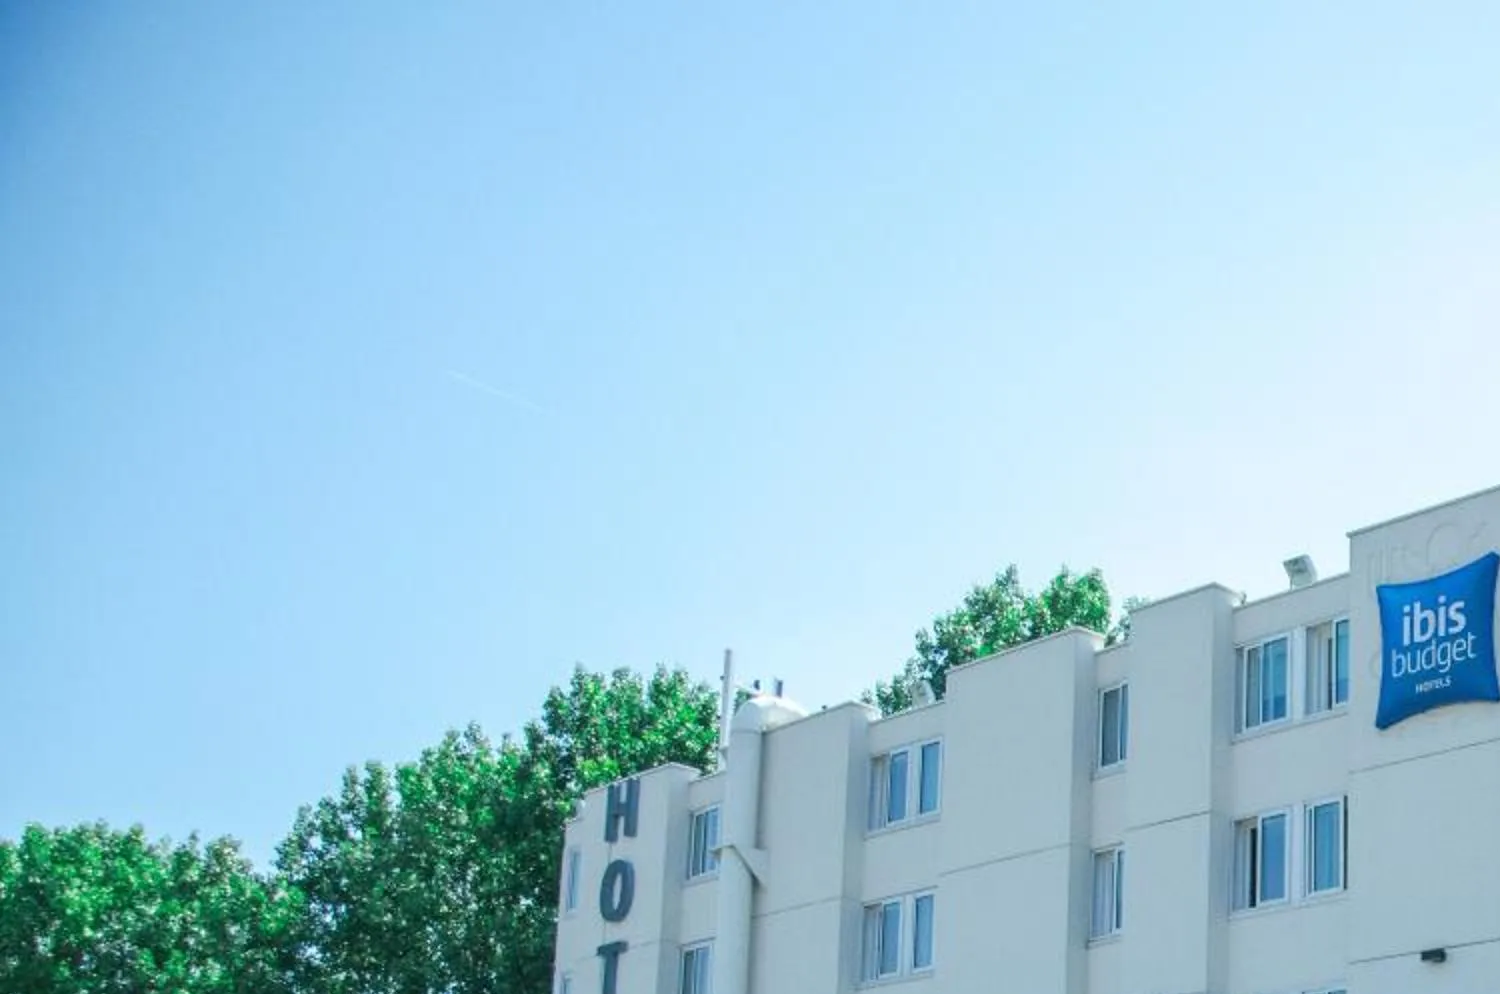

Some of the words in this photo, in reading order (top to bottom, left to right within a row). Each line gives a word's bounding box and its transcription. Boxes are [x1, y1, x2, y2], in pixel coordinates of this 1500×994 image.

[1402, 595, 1467, 647] ibis
[1391, 631, 1477, 679] budget
[1415, 675, 1452, 694] HOTELS
